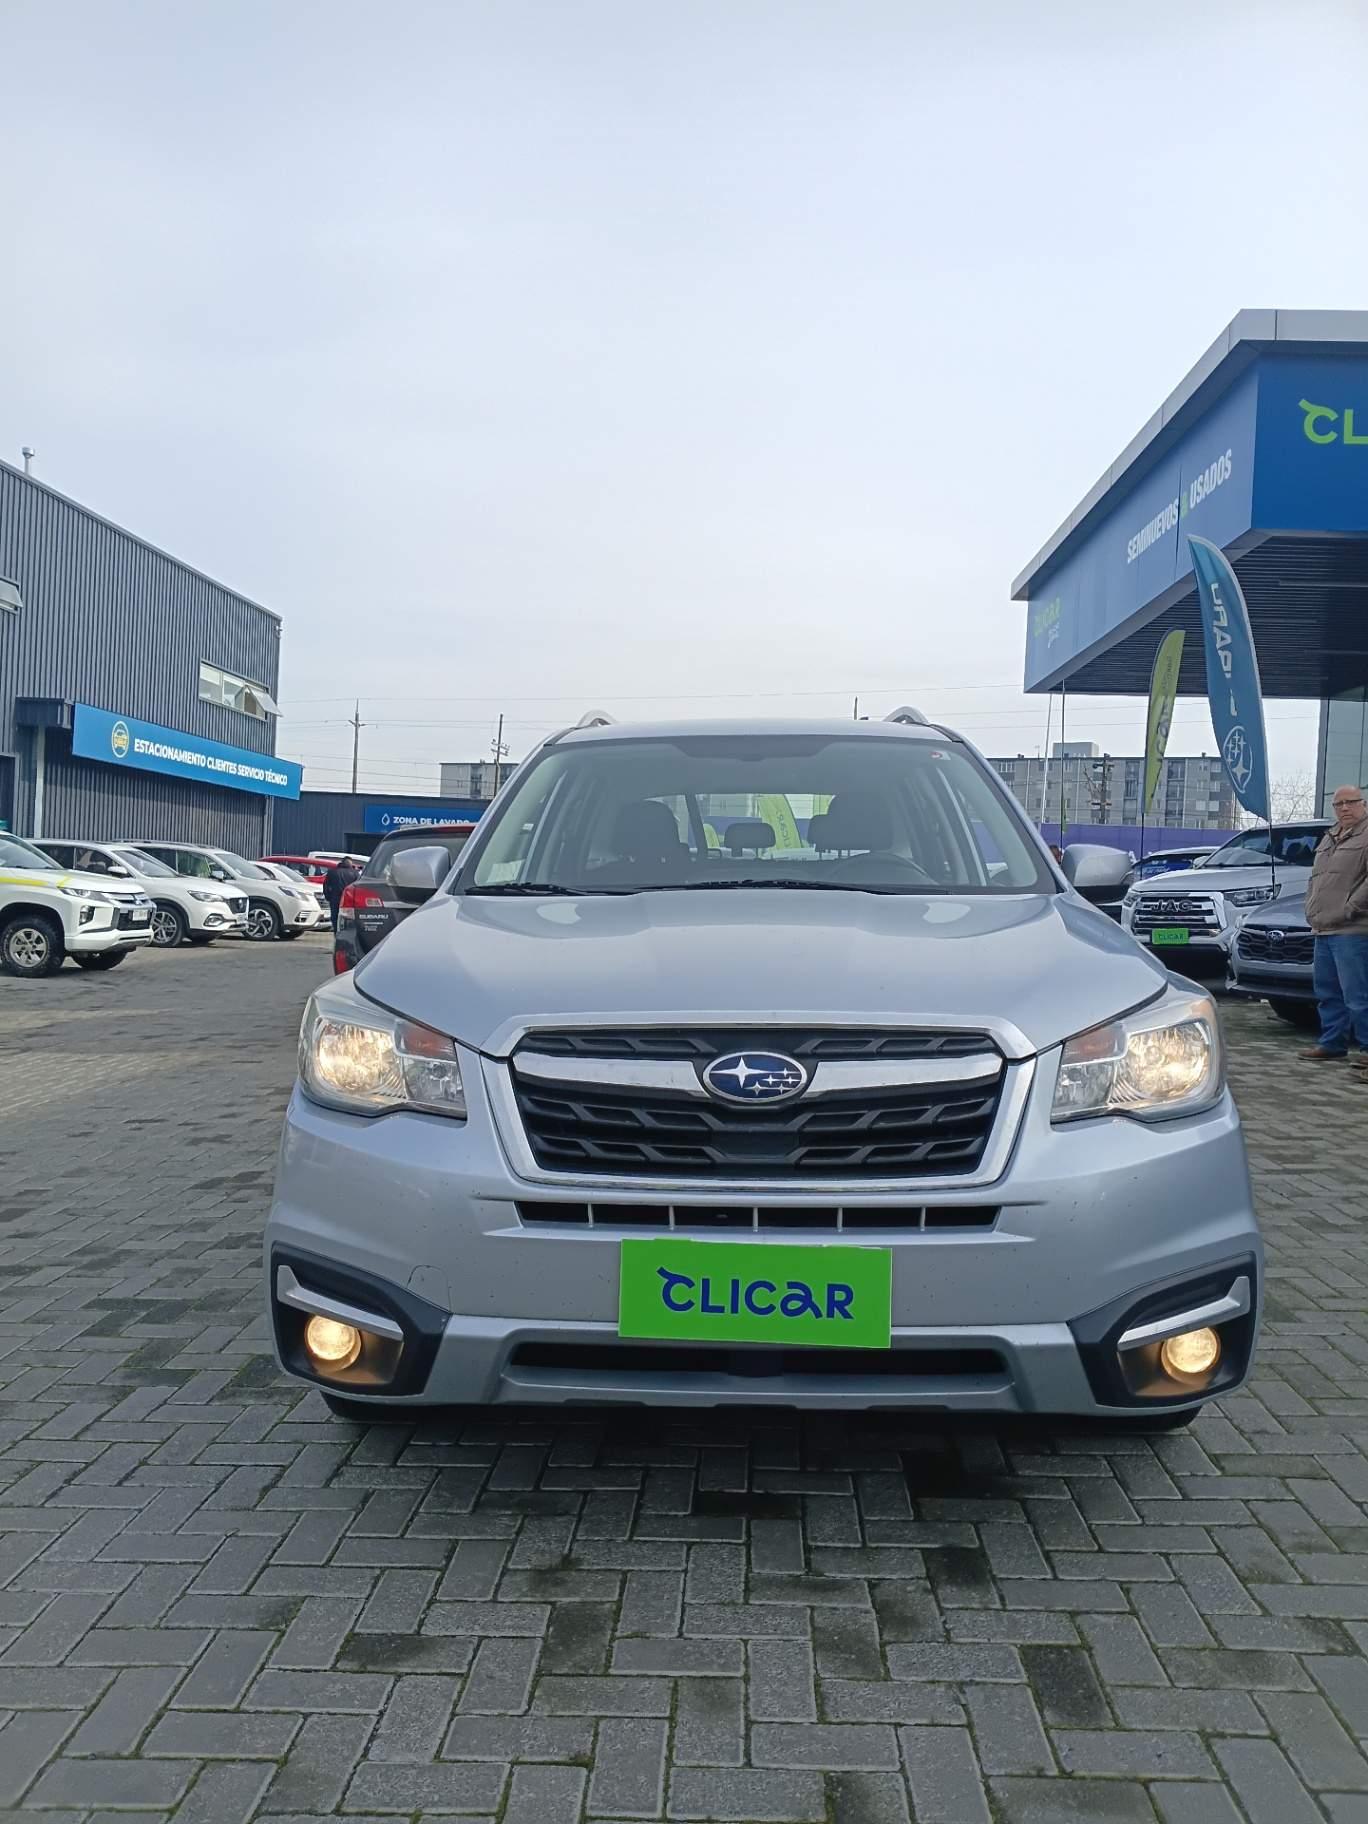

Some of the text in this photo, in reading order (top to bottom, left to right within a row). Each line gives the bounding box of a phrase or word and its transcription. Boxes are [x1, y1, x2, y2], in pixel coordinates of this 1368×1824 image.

[1127, 498, 1180, 564] SEMINUEVOS
[1189, 448, 1232, 510] USADOS
[134, 738, 288, 786] ESTACIONAMIENTO CLIENTES SERVICIO TÉCNICO
[393, 816, 418, 825] ZONA
[1150, 899, 1192, 912] JAC
[656, 1266, 855, 1320] CLICAR
